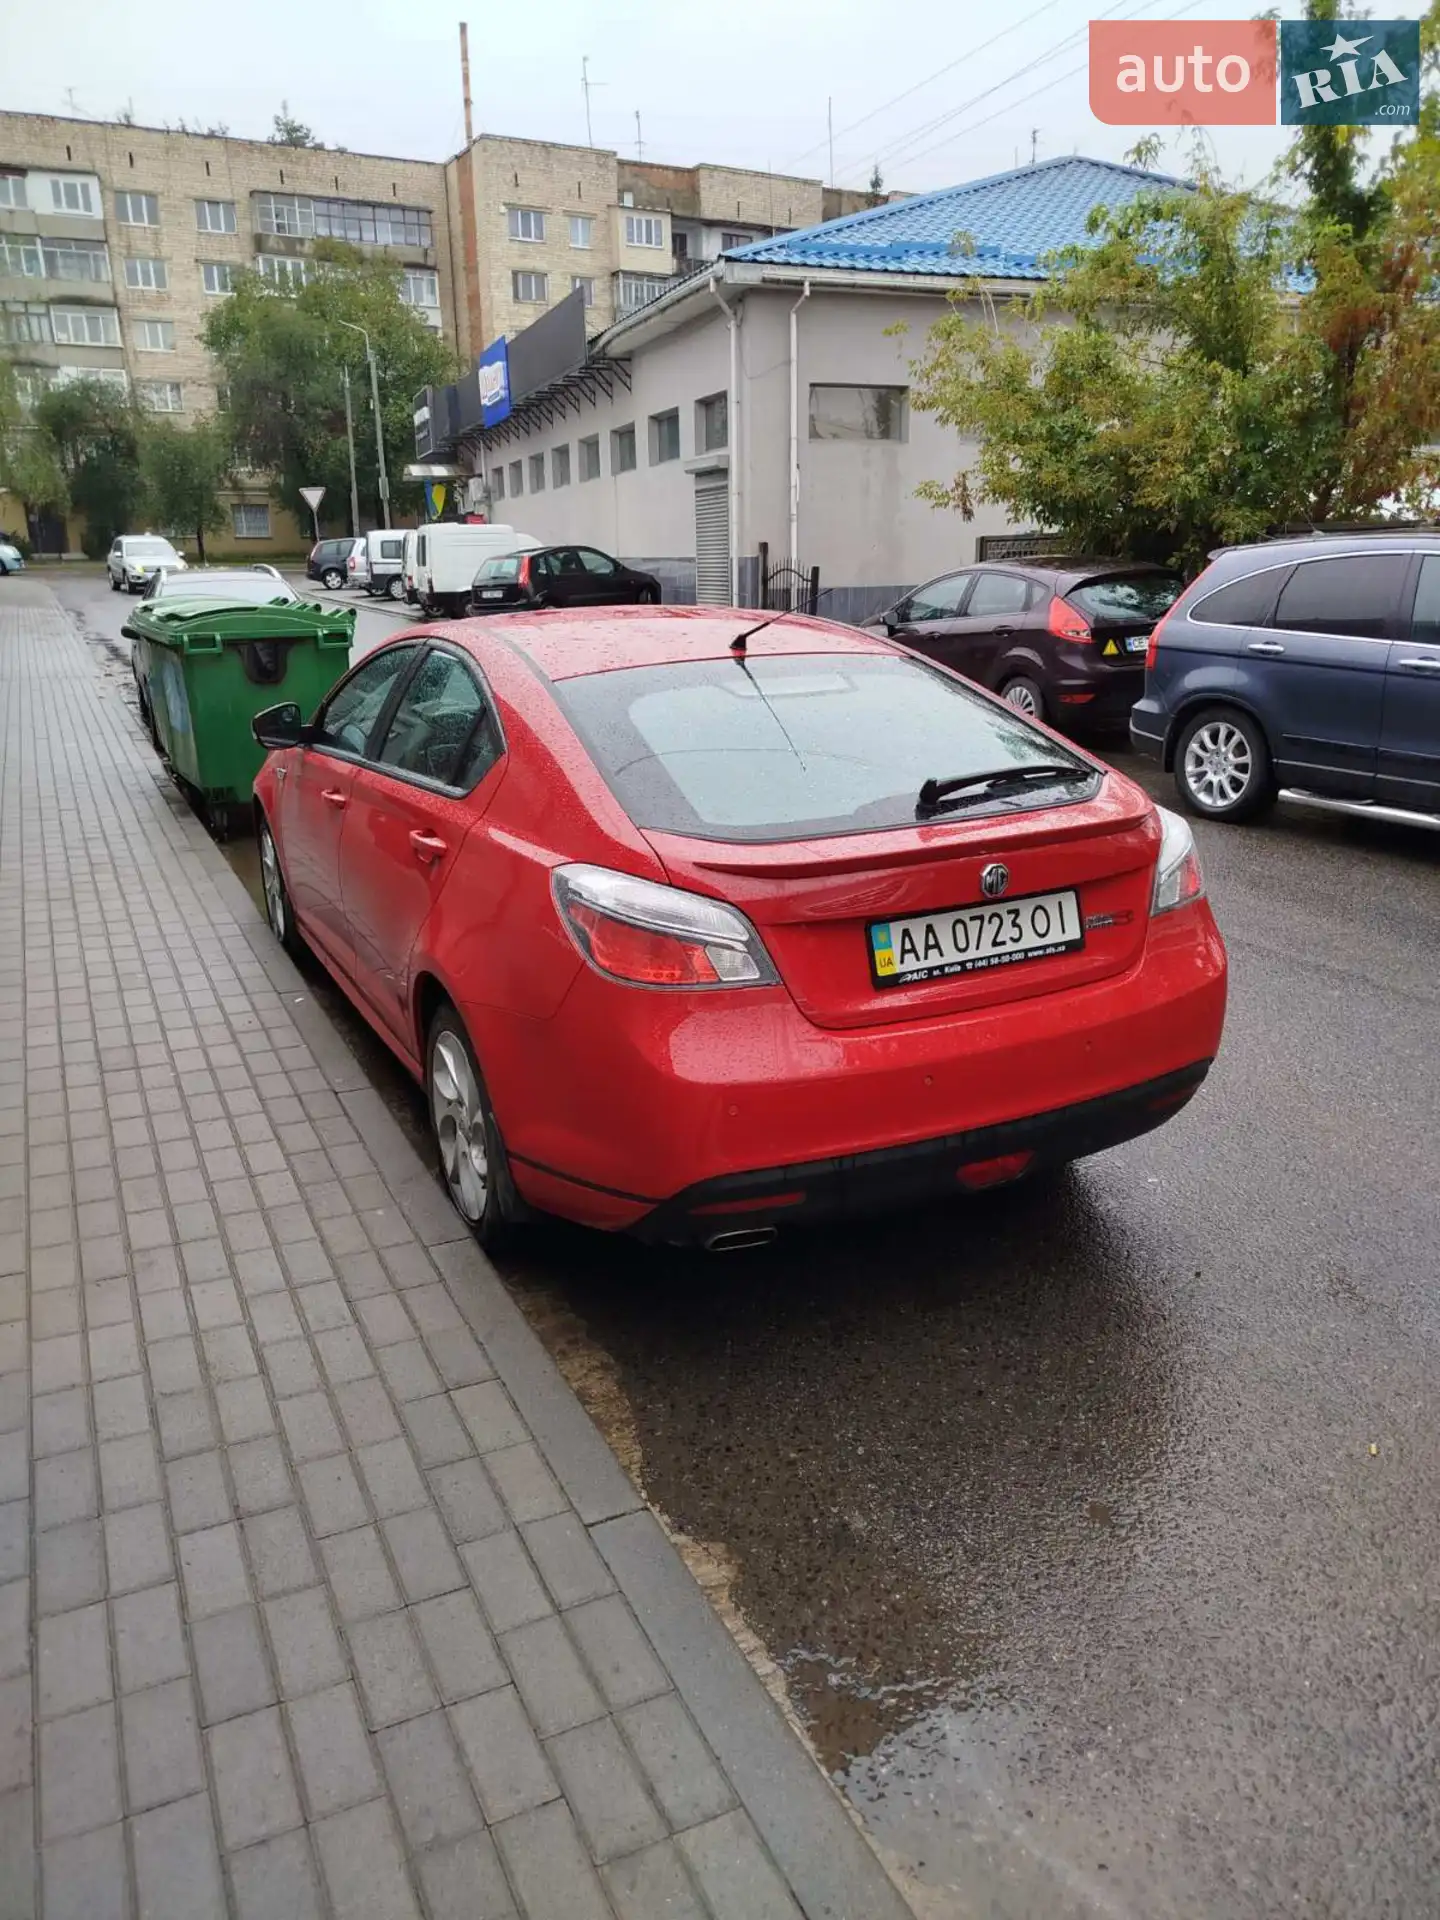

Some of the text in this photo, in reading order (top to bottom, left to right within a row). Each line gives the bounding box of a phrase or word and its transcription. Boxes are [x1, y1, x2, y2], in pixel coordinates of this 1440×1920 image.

[899, 924, 944, 964] AA
[952, 908, 1023, 954] 0723
[879, 957, 893, 968] UA
